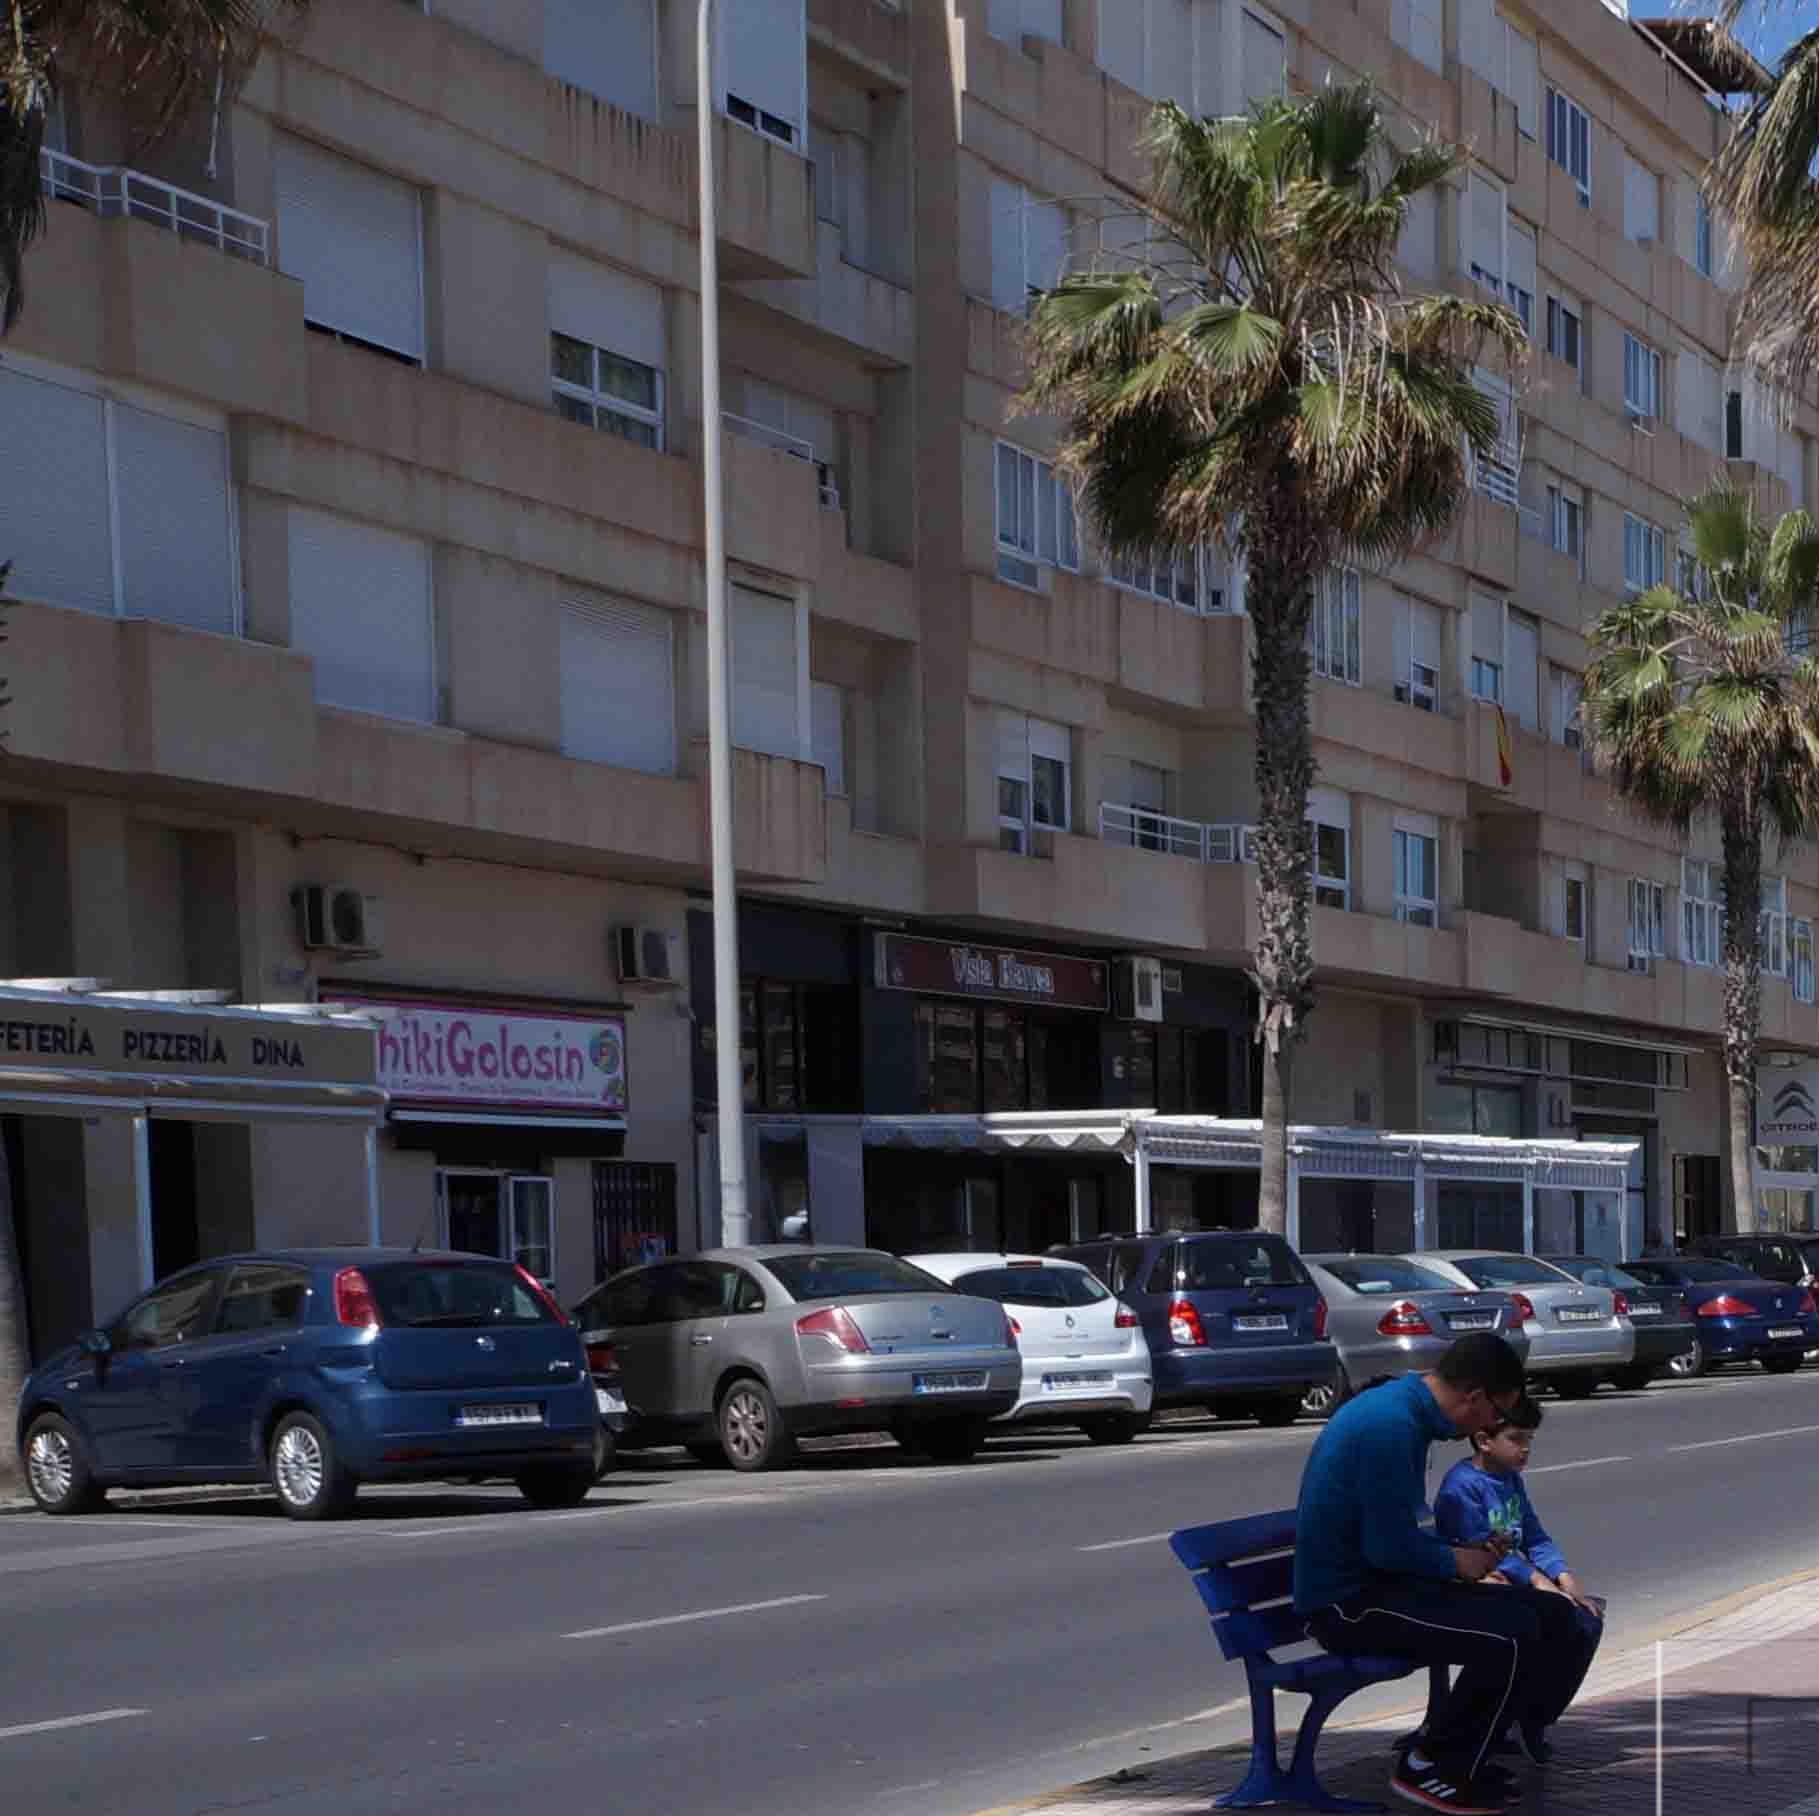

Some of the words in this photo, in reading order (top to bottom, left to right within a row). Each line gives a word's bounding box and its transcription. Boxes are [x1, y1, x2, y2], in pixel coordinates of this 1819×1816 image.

[123, 1026, 227, 1065] PIZZERÍA
[251, 1036, 305, 1068] DINA
[378, 1019, 586, 1082] hikiGolosin
